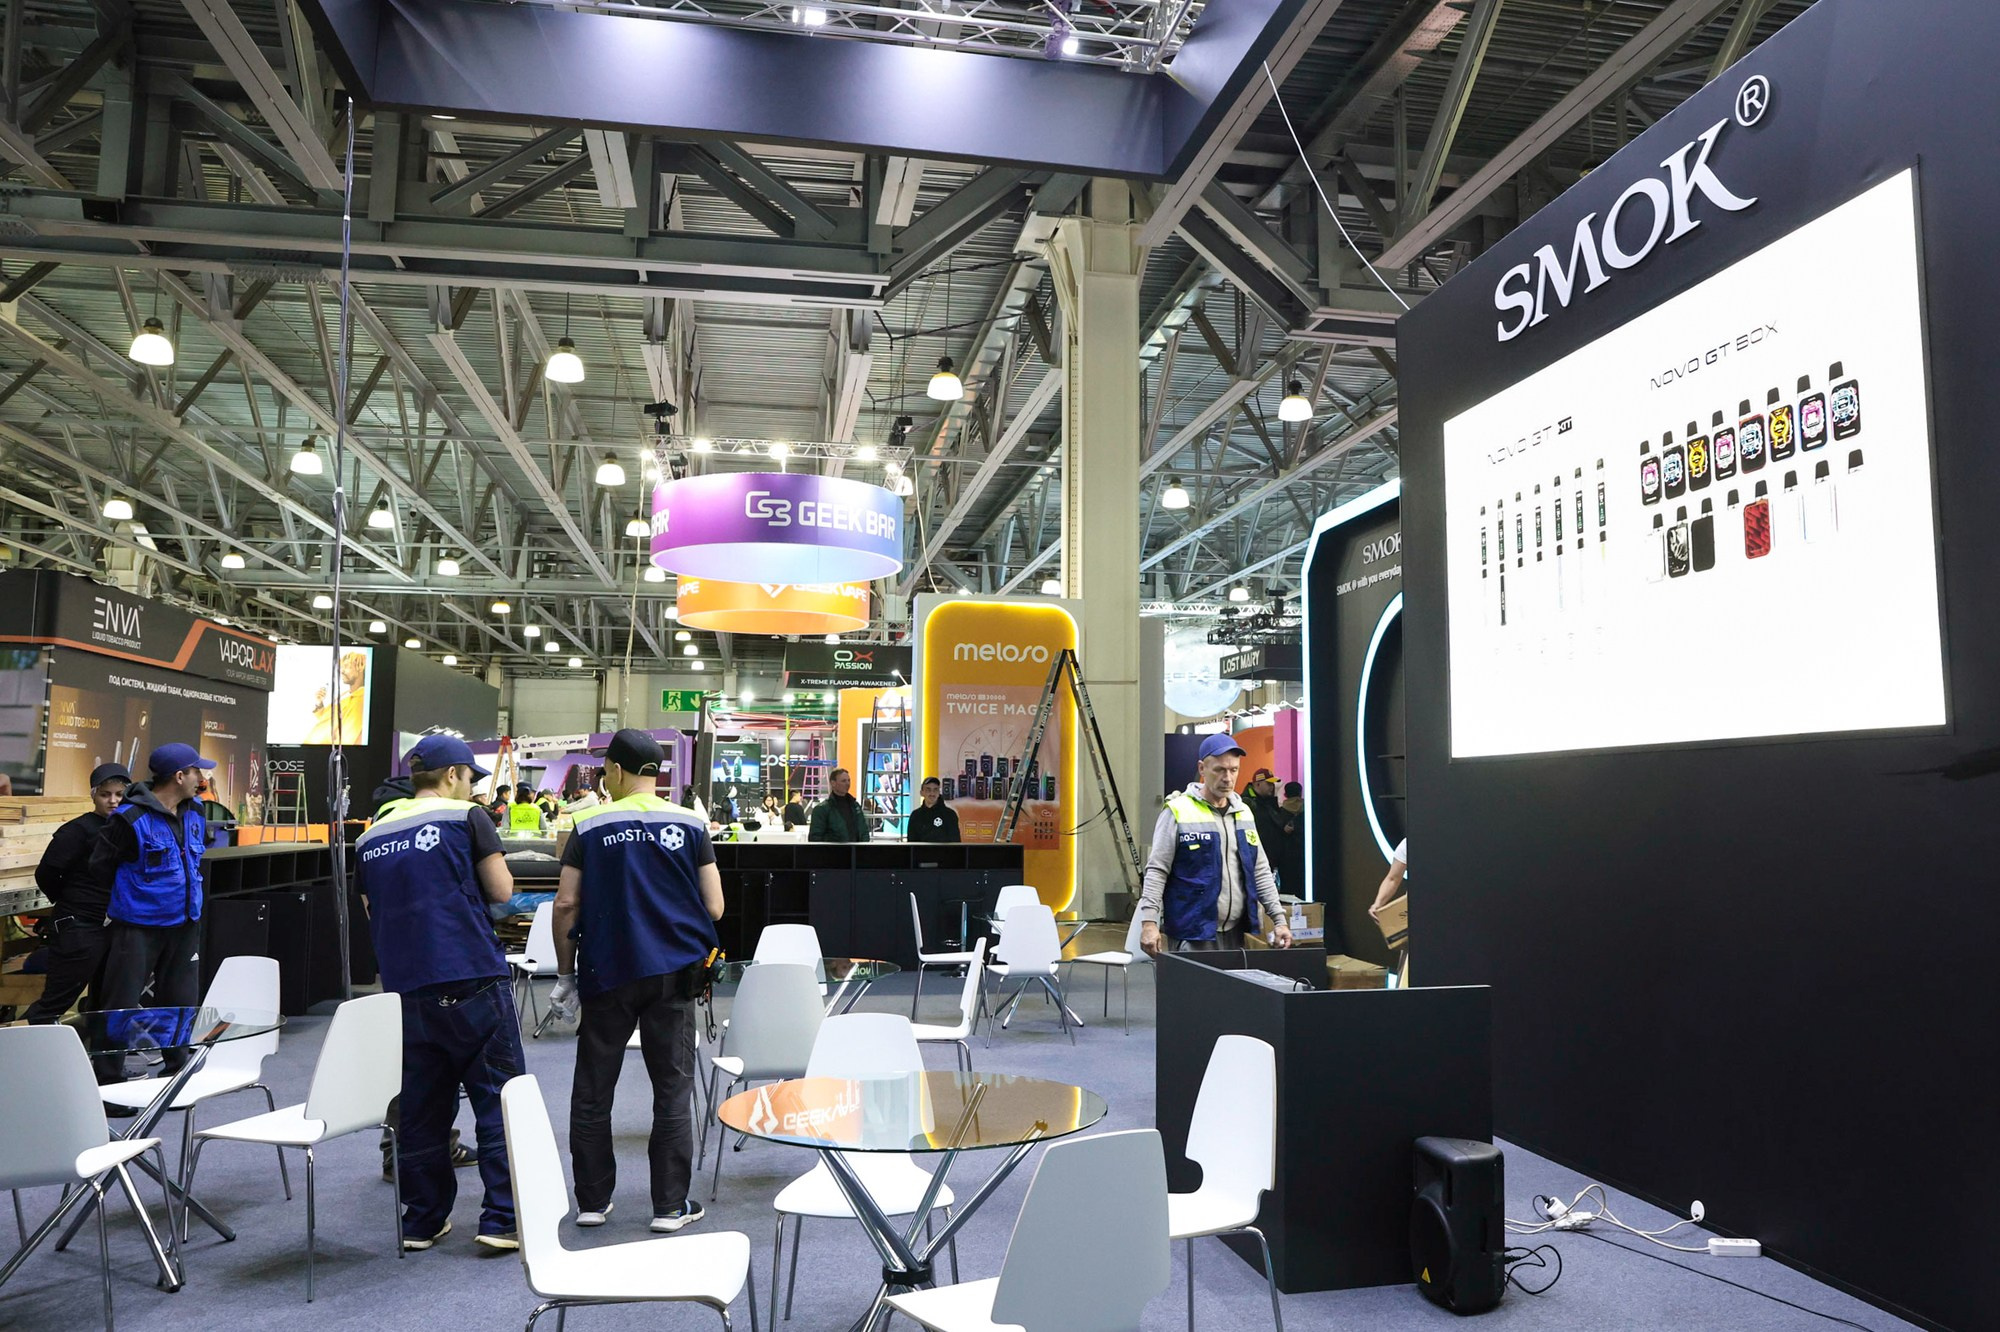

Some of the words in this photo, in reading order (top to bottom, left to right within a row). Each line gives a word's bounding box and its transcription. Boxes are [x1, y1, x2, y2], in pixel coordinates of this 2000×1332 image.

[1494, 118, 1758, 342] SMOK
[1650, 357, 1700, 391] NOVO
[1705, 341, 1731, 366] GT
[1736, 319, 1778, 352] BOX
[1532, 425, 1552, 447] GT
[650, 507, 670, 539] BAR
[798, 500, 863, 533] GEEK
[865, 509, 896, 542] BAR
[93, 596, 141, 639] ENVA
[91, 630, 106, 642] LIQUID
[106, 634, 123, 646] TOBACCO
[123, 639, 142, 650] PRODUCT
[219, 637, 275, 675] VAPORLAX
[834, 650, 874, 662] OX
[953, 642, 1049, 664] meloso
[1222, 655, 1240, 674] LOST
[1240, 650, 1260, 669] MARY
[834, 662, 873, 670] PASSION
[108, 674, 121, 687] ПОД
[121, 677, 146, 691] СИСТЕМА,
[146, 682, 167, 693] ЖИДКИЙ
[167, 685, 182, 697] ТАБАК,
[182, 689, 213, 702] ОДНОРАЗОВЫЕ
[213, 694, 237, 706] УСТРОЙСТВА
[829, 679, 860, 687] FLAVOUR
[946, 702, 998, 715] TWICE
[1003, 703, 1053, 716] MAG
[521, 741, 552, 749] LOST
[556, 738, 584, 746] VAPE
[603, 828, 655, 847] moSTra
[363, 839, 410, 862] moSTra
